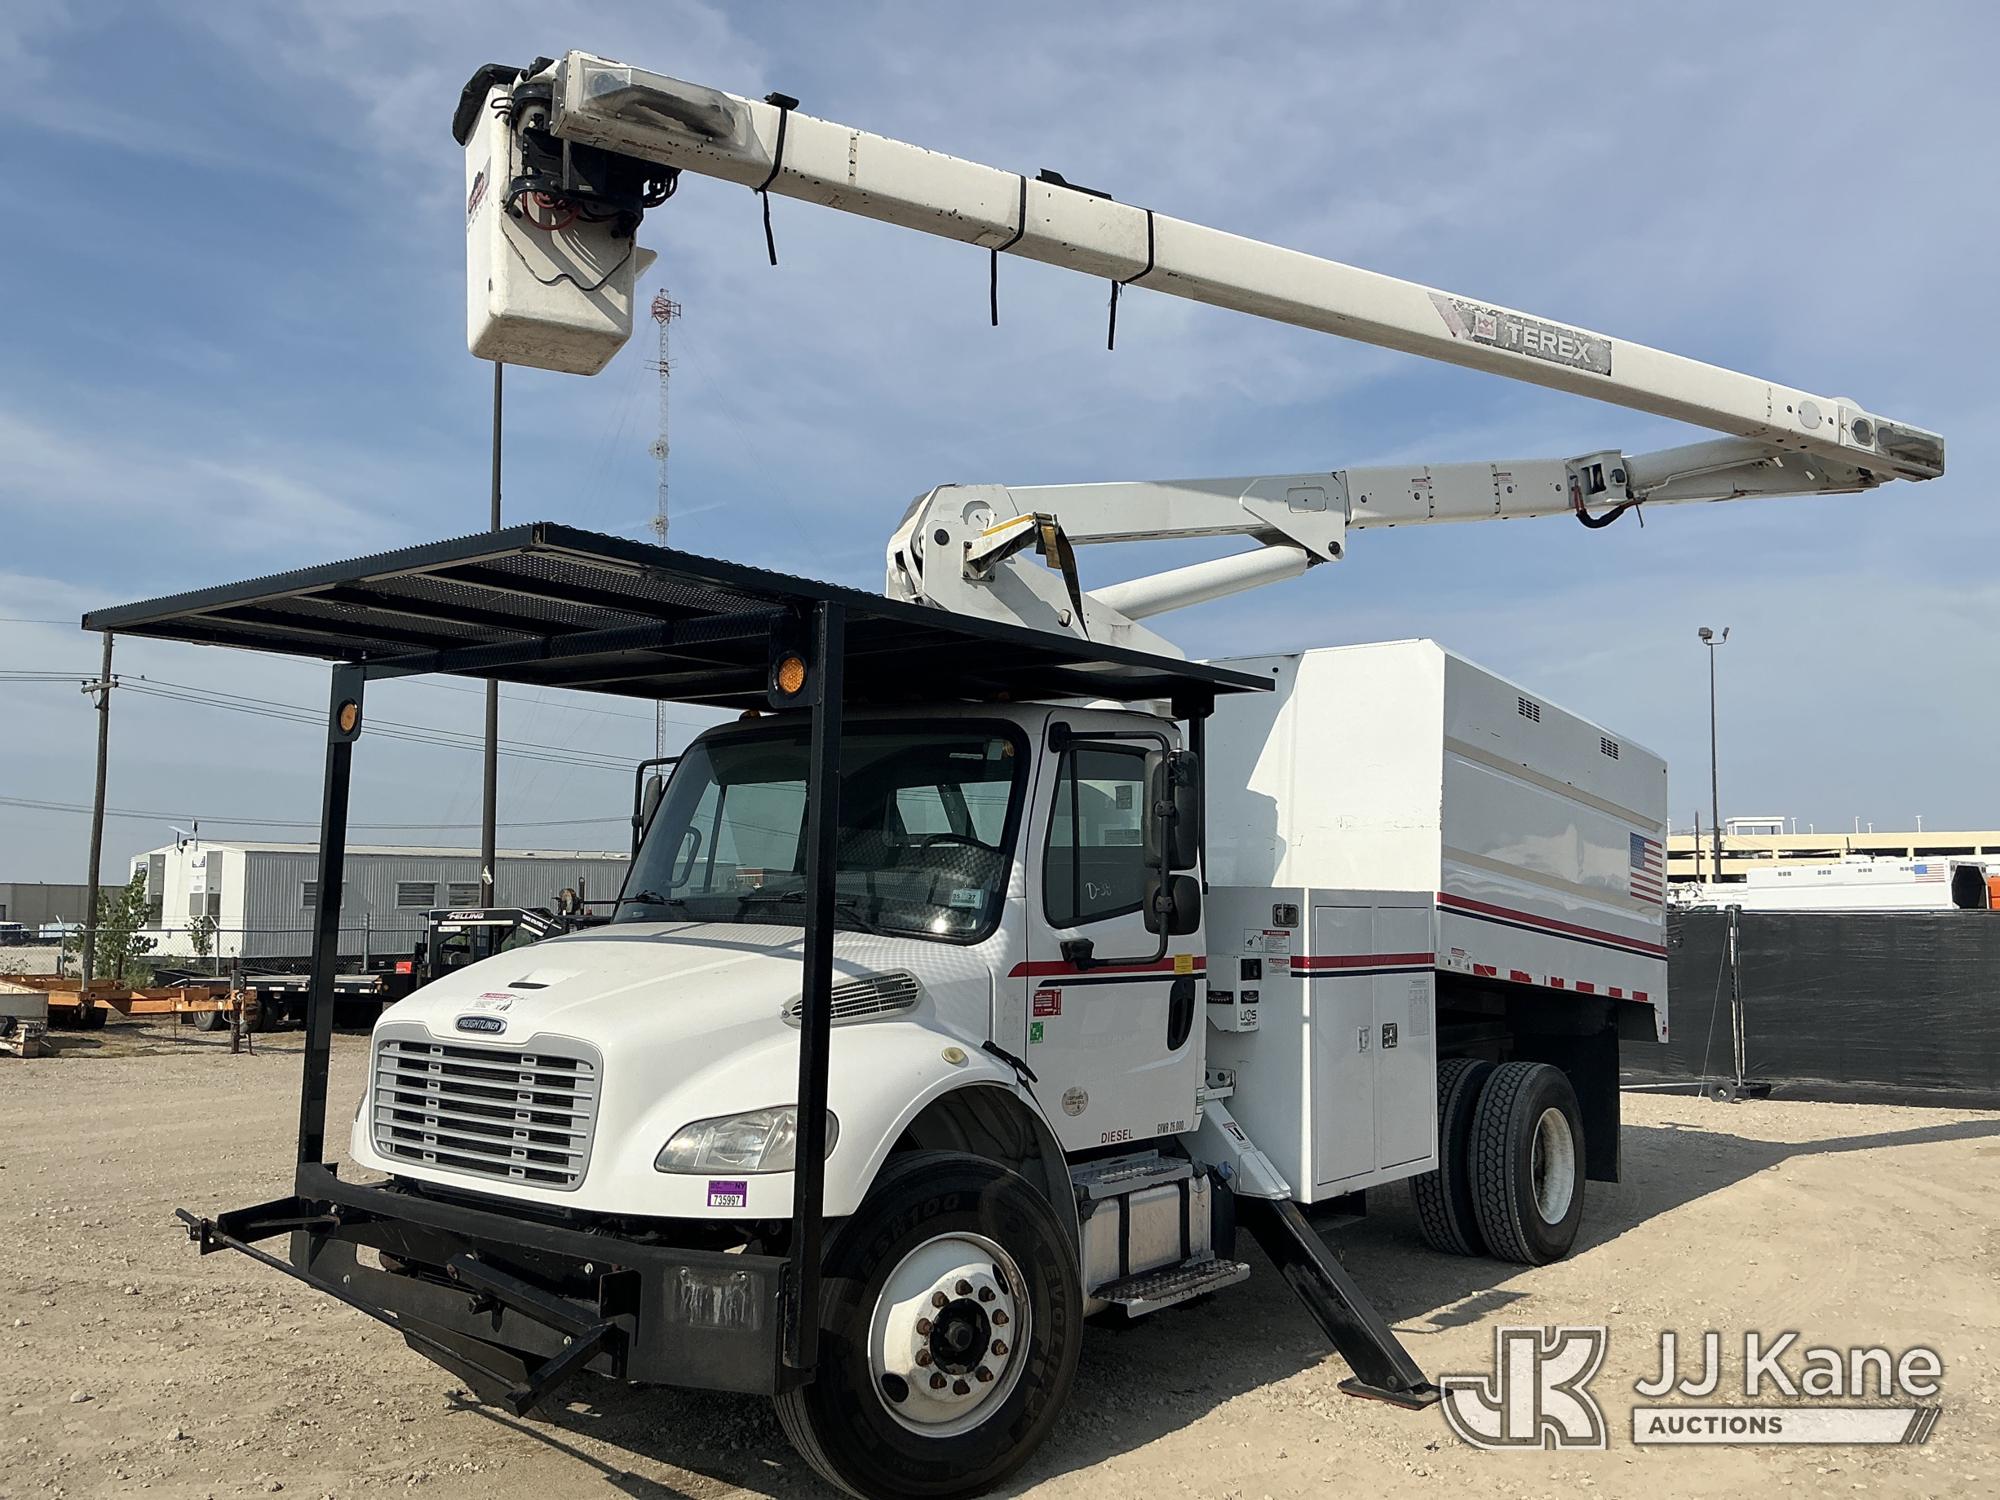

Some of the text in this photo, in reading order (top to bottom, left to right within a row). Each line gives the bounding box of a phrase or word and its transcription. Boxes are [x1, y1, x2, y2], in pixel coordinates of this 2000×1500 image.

[1505, 321, 1591, 363] TEREX
[458, 1019, 500, 1031] FREIGHTLINER
[1101, 1128, 1134, 1144] DIESEL
[713, 1194, 740, 1206] 735997
